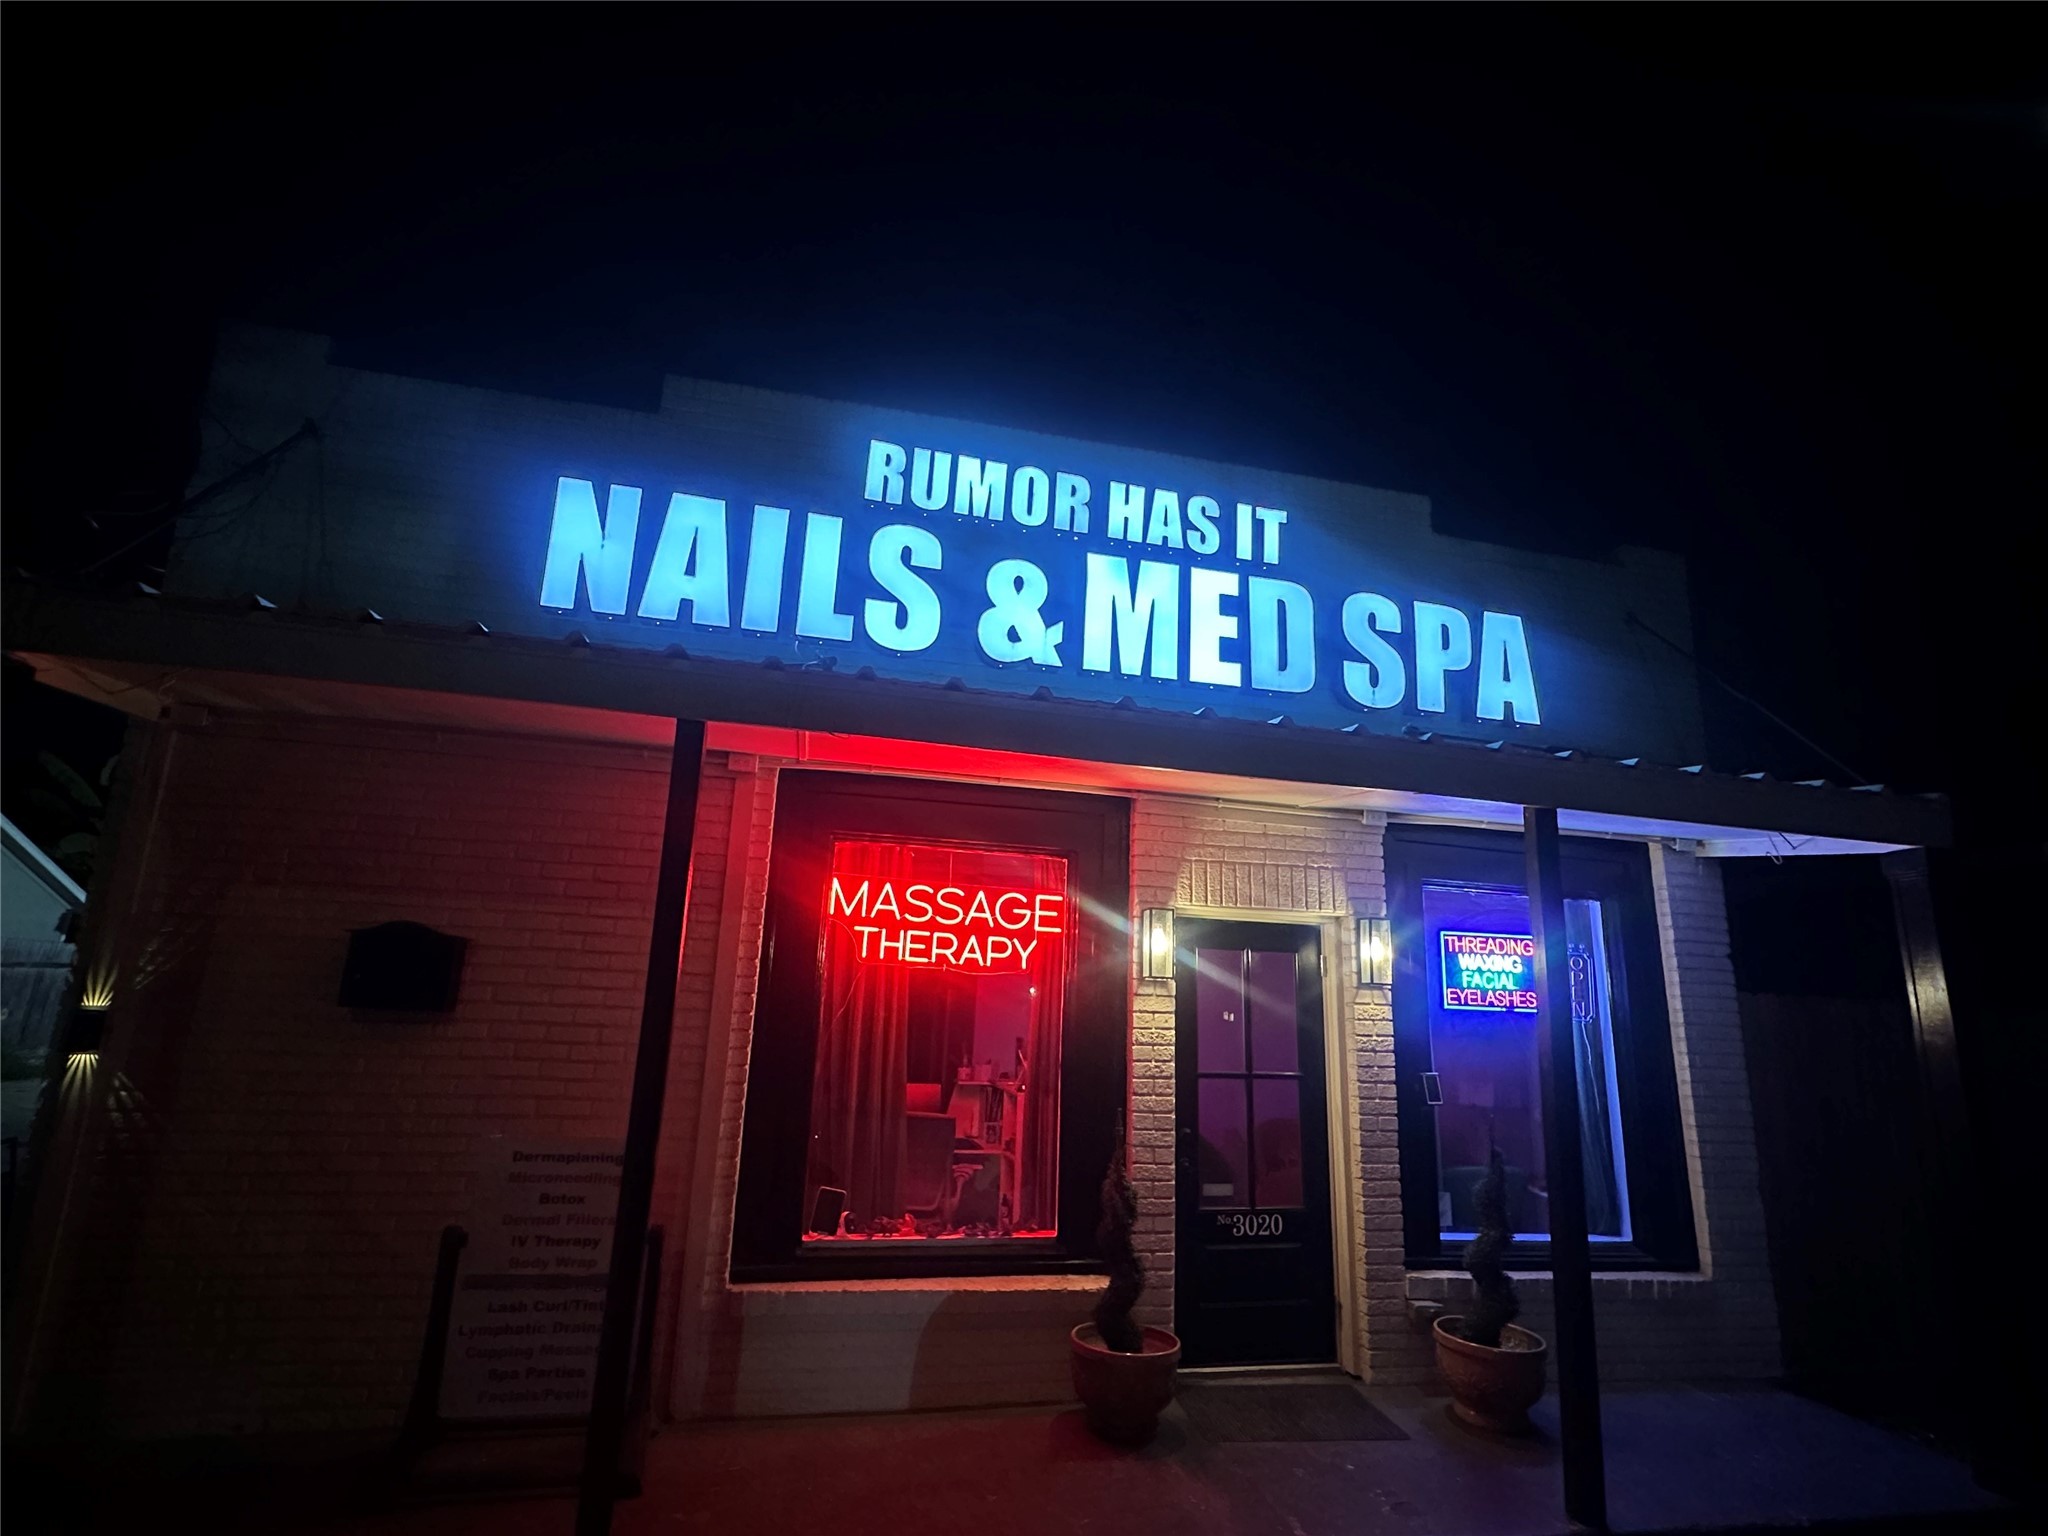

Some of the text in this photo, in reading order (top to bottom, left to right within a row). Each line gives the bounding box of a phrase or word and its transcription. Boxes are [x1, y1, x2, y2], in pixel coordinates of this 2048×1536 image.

[864, 439, 1288, 565] RUMOR HAS IT
[539, 476, 1541, 725] NAILS & MED SPA
[829, 877, 1064, 933] MASSAGE
[853, 925, 1038, 970] THERAPY
[1445, 936, 1534, 956] THREADING
[1458, 953, 1523, 974] WAXING
[1461, 971, 1520, 990] FACIAL
[1447, 988, 1538, 1008] EYELASHES
[512, 1151, 624, 1167] Dermaplaning
[538, 1192, 587, 1205] Botox
[502, 1213, 562, 1227] Dermal
[1232, 1213, 1284, 1237] 3020
[511, 1234, 602, 1250] IV Therapy
[508, 1256, 599, 1271] Body Wrap
[487, 1300, 528, 1313] Lash
[458, 1322, 546, 1339] Lymphatic
[465, 1345, 534, 1360] Cupping
[487, 1365, 587, 1383] Spa Parties
